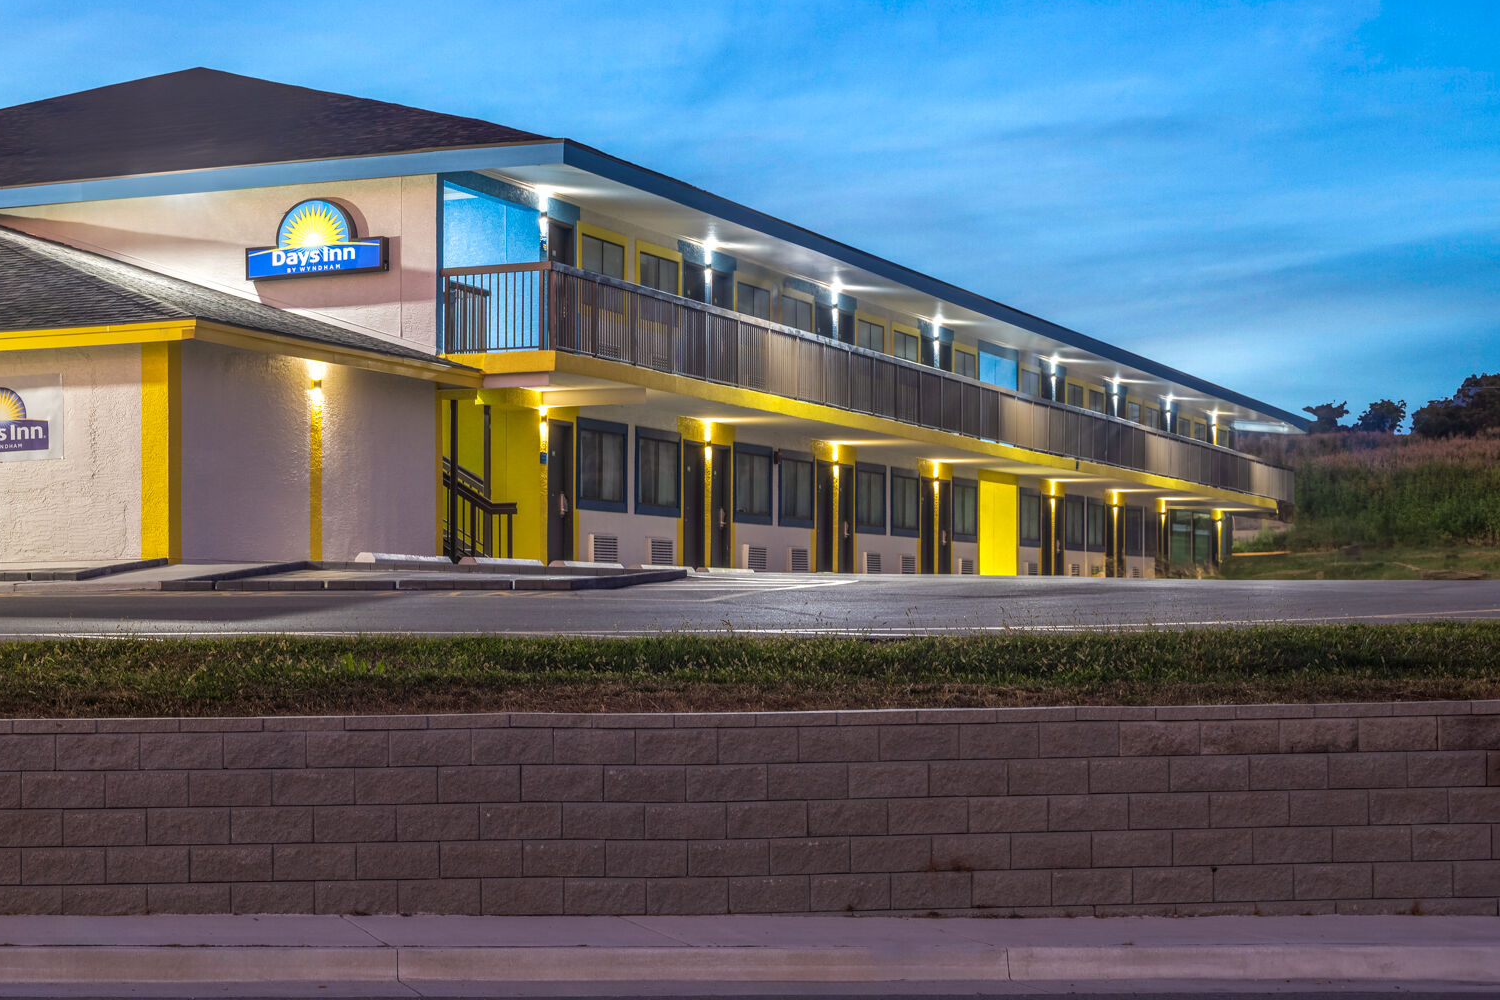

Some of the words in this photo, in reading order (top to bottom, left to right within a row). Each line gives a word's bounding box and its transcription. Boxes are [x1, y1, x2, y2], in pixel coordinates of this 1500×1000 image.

[271, 250, 320, 267] Days
[323, 246, 356, 262] Inn
[299, 263, 341, 272] WYNDHAM
